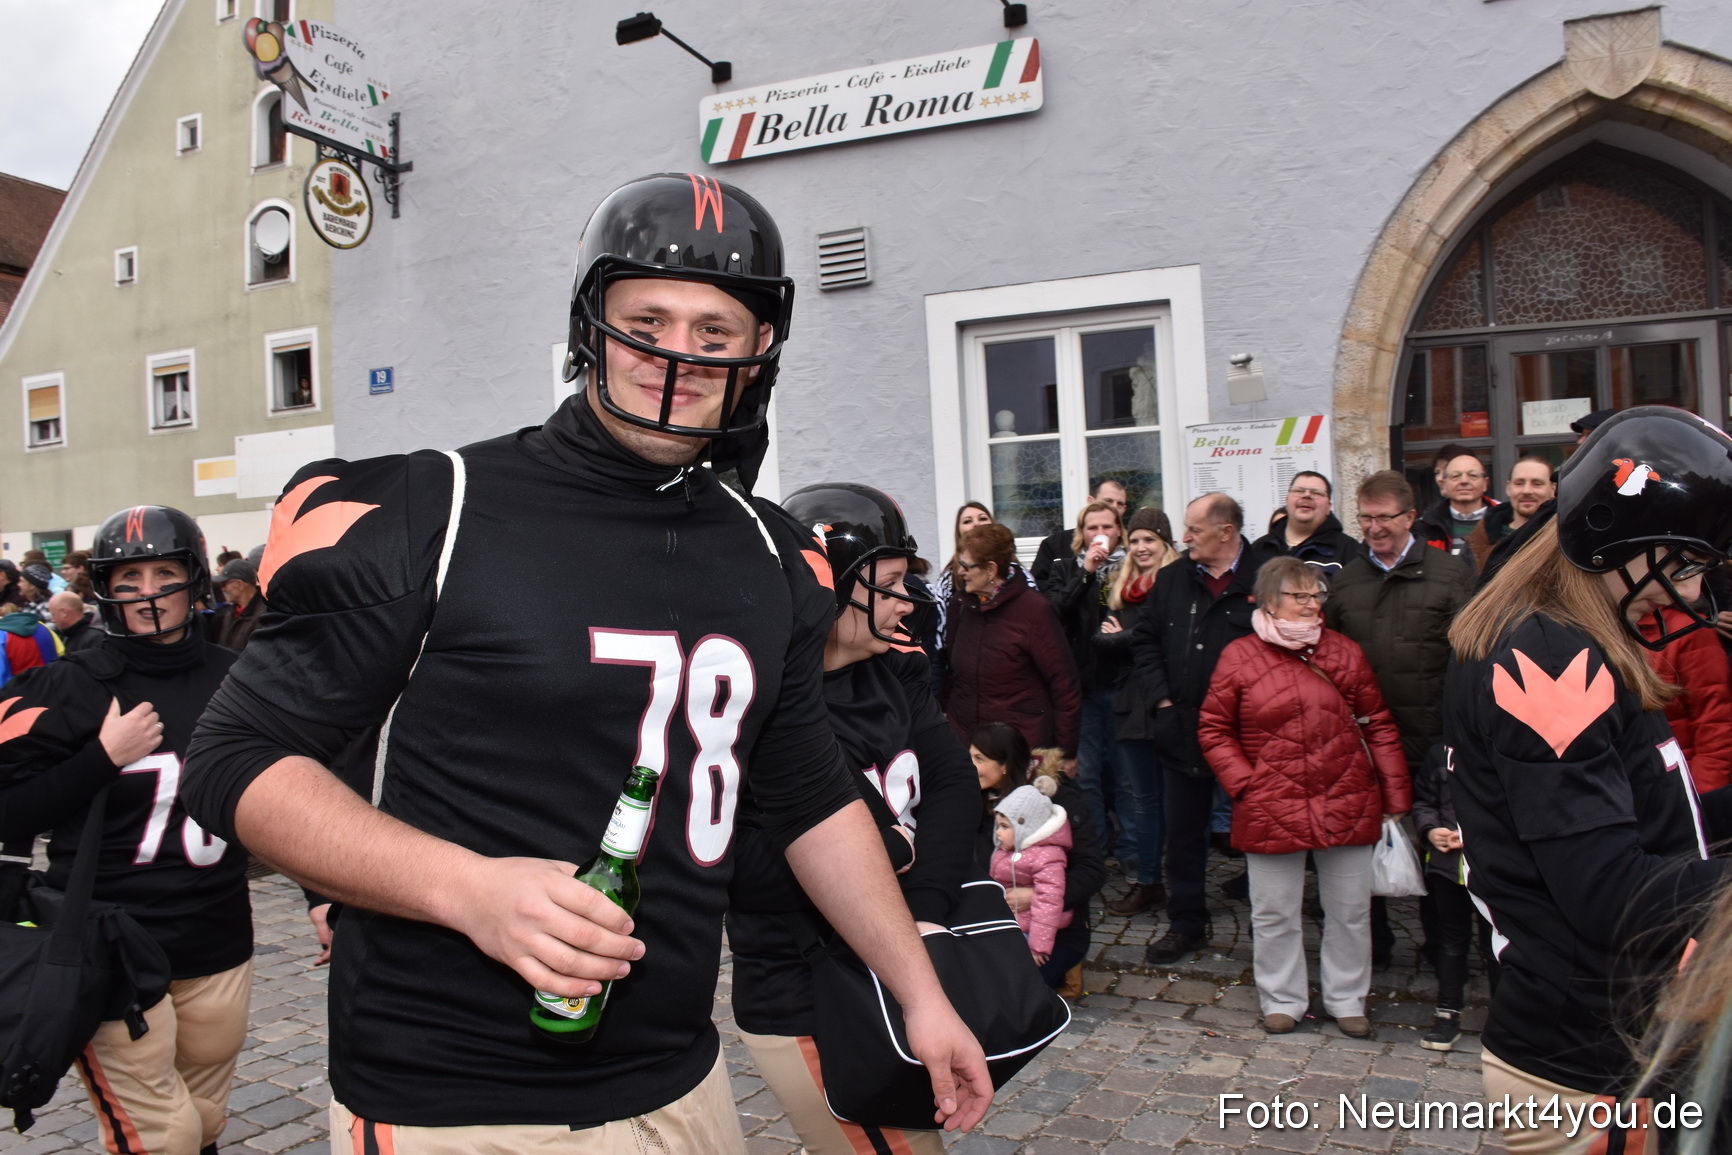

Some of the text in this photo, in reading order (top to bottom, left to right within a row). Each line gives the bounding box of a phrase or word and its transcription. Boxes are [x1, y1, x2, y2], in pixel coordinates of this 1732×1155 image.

[310, 24, 366, 60] Pizzeria
[325, 53, 354, 75] Café
[308, 68, 367, 102] Eisdiele
[765, 82, 828, 104] Pizzeria
[847, 71, 885, 92] Café
[903, 56, 971, 79] Eisdiele
[290, 110, 337, 134] Roma
[320, 110, 360, 133] Bella
[753, 90, 975, 146] Bella Roma
[376, 370, 387, 383] 19
[1192, 435, 1241, 448] Bella
[1210, 447, 1263, 457] Roma
[588, 626, 757, 867] 78
